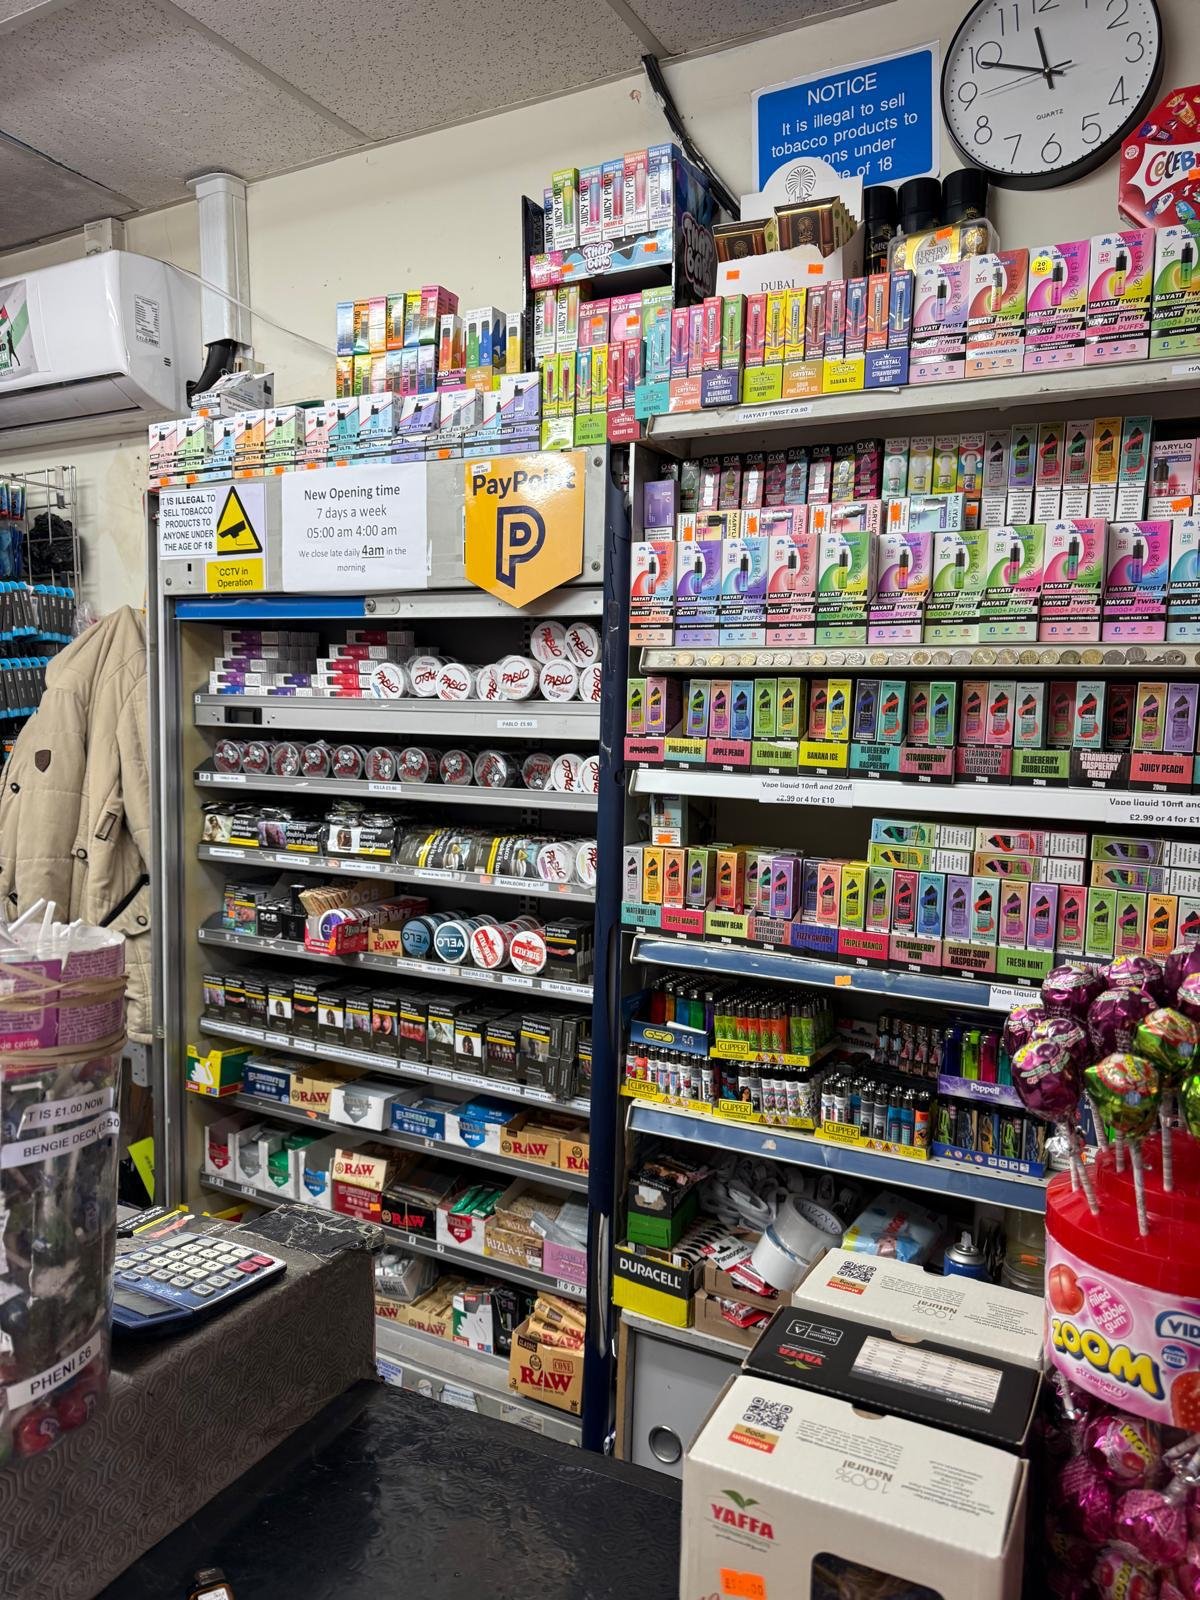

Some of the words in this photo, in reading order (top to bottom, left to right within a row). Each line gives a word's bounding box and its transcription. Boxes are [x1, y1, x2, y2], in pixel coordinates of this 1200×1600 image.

[998, 3, 1019, 36] 11
[1106, 0, 1129, 30] 2
[1125, 32, 1144, 63] 3
[969, 41, 1002, 74] 10
[807, 72, 878, 106] NOTICE
[958, 81, 978, 111] 9
[1108, 75, 1130, 106] 4
[782, 122, 791, 136] It
[797, 119, 807, 132] is
[813, 106, 855, 127] illegal
[860, 103, 874, 117] to
[880, 92, 905, 111] sell
[1036, 108, 1064, 121] QUARTZ
[771, 135, 828, 158] tobacco
[834, 117, 898, 146] products
[904, 112, 918, 126] to
[974, 115, 992, 145] 8
[1081, 112, 1102, 144] 5
[854, 136, 897, 157] under
[1003, 134, 1022, 164] 7
[1041, 133, 1062, 163] 6
[856, 162, 871, 177] of
[877, 156, 893, 172] 18
[760, 278, 795, 292] DUBAI
[742, 411, 767, 420] HAYATI
[768, 408, 790, 417] TWIST
[1154, 442, 1193, 453] MARYLIQ
[166, 497, 174, 505] IS
[175, 495, 205, 505] ILLEGAL
[207, 494, 216, 503] TO
[304, 489, 327, 501] New
[329, 485, 373, 501] Opening
[375, 484, 401, 496] time
[163, 509, 179, 518] SELL
[181, 506, 213, 516] TOBACCO
[317, 507, 322, 519] 7
[325, 506, 348, 521] days
[350, 508, 357, 518] a
[360, 504, 387, 517] week
[165, 519, 200, 529] PRODUCTS
[202, 518, 211, 526] TO
[163, 531, 192, 540] ANYONE
[193, 530, 214, 539] UNDER
[306, 526, 335, 539] 05:00
[337, 527, 353, 538] am
[356, 524, 379, 537] 4:00
[381, 525, 397, 536] am
[164, 543, 177, 552] THE
[178, 543, 192, 551] AGE
[193, 542, 202, 550] OF
[204, 541, 213, 550] 18
[298, 550, 310, 558] We
[310, 549, 329, 558] close
[329, 548, 342, 557] late
[343, 547, 360, 559] daily
[361, 545, 385, 557] 4am
[386, 547, 393, 555] in
[394, 546, 407, 555] the
[219, 567, 240, 577] CCTV
[241, 567, 249, 576] in
[336, 563, 366, 573] morning
[217, 578, 253, 589] Operation
[541, 627, 562, 657] PABLO
[439, 674, 468, 692] PABLO
[502, 668, 530, 685] PABLO
[543, 674, 573, 686] PABLO
[905, 754, 946, 763] STRAWBERRY
[1022, 755, 1059, 765] BLUEBERRY
[1079, 752, 1122, 763] STRAWBERRY
[917, 762, 933, 772] KIWI
[1021, 764, 1060, 775] BUBBLEGUM
[1082, 761, 1119, 772] RASPBERRY
[1087, 769, 1112, 779] CHERRY
[1139, 763, 1159, 773] JUICY
[1161, 764, 1184, 774] PEACH
[761, 781, 778, 789] Vape
[779, 781, 799, 790] liquid
[819, 783, 833, 791] and
[810, 795, 820, 803] for
[821, 795, 835, 804] £10
[1109, 797, 1131, 807] Vape
[1133, 797, 1160, 808] liquid
[1129, 813, 1154, 823] £2.99
[1155, 815, 1165, 823] or
[1166, 814, 1172, 823] 4
[1174, 814, 1187, 824] for
[259, 912, 278, 922] OCB
[374, 939, 399, 951] RAW
[436, 936, 465, 948] VELO
[843, 938, 860, 949] TRIPLE
[860, 940, 883, 951] MANGO
[972, 949, 990, 960] SOUR
[950, 955, 987, 970] RASPBERRY
[1006, 955, 1026, 968] FRESH
[1026, 957, 1044, 971] MINT
[991, 987, 1013, 996] Vape
[1014, 988, 1037, 998] liquid
[14, 1039, 40, 1049] cerise
[719, 1041, 748, 1052] CLIPPER
[300, 1091, 330, 1103] RAW
[39, 1107, 52, 1121] IS
[54, 1102, 82, 1118] £1.00
[83, 1096, 104, 1111] NOW
[826, 1123, 857, 1138] CLIPPER
[23, 1138, 70, 1158] BENGIE
[72, 1126, 98, 1145] DECK
[512, 1142, 549, 1156] RAW
[344, 1163, 376, 1176] RAW
[392, 1212, 426, 1229] RAW
[714, 1245, 749, 1264] Panasonic
[619, 1257, 682, 1290] DURACELL
[912, 1304, 954, 1321] 100%
[917, 1298, 958, 1315] Natural
[1095, 1303, 1126, 1325] bubble
[1104, 1315, 1127, 1333] gum
[518, 1337, 538, 1352] CLASSIC
[553, 1359, 574, 1373] CONE
[1052, 1317, 1166, 1401] ZOOM
[29, 1361, 77, 1396] PHENI
[78, 1346, 93, 1366] £6
[520, 1365, 574, 1392] RAW
[1074, 1366, 1129, 1398] strawberry
[731, 1431, 772, 1453] Medium
[841, 1458, 894, 1483] Natural
[835, 1466, 890, 1495] 100%
[710, 1502, 775, 1540] YAFFA
